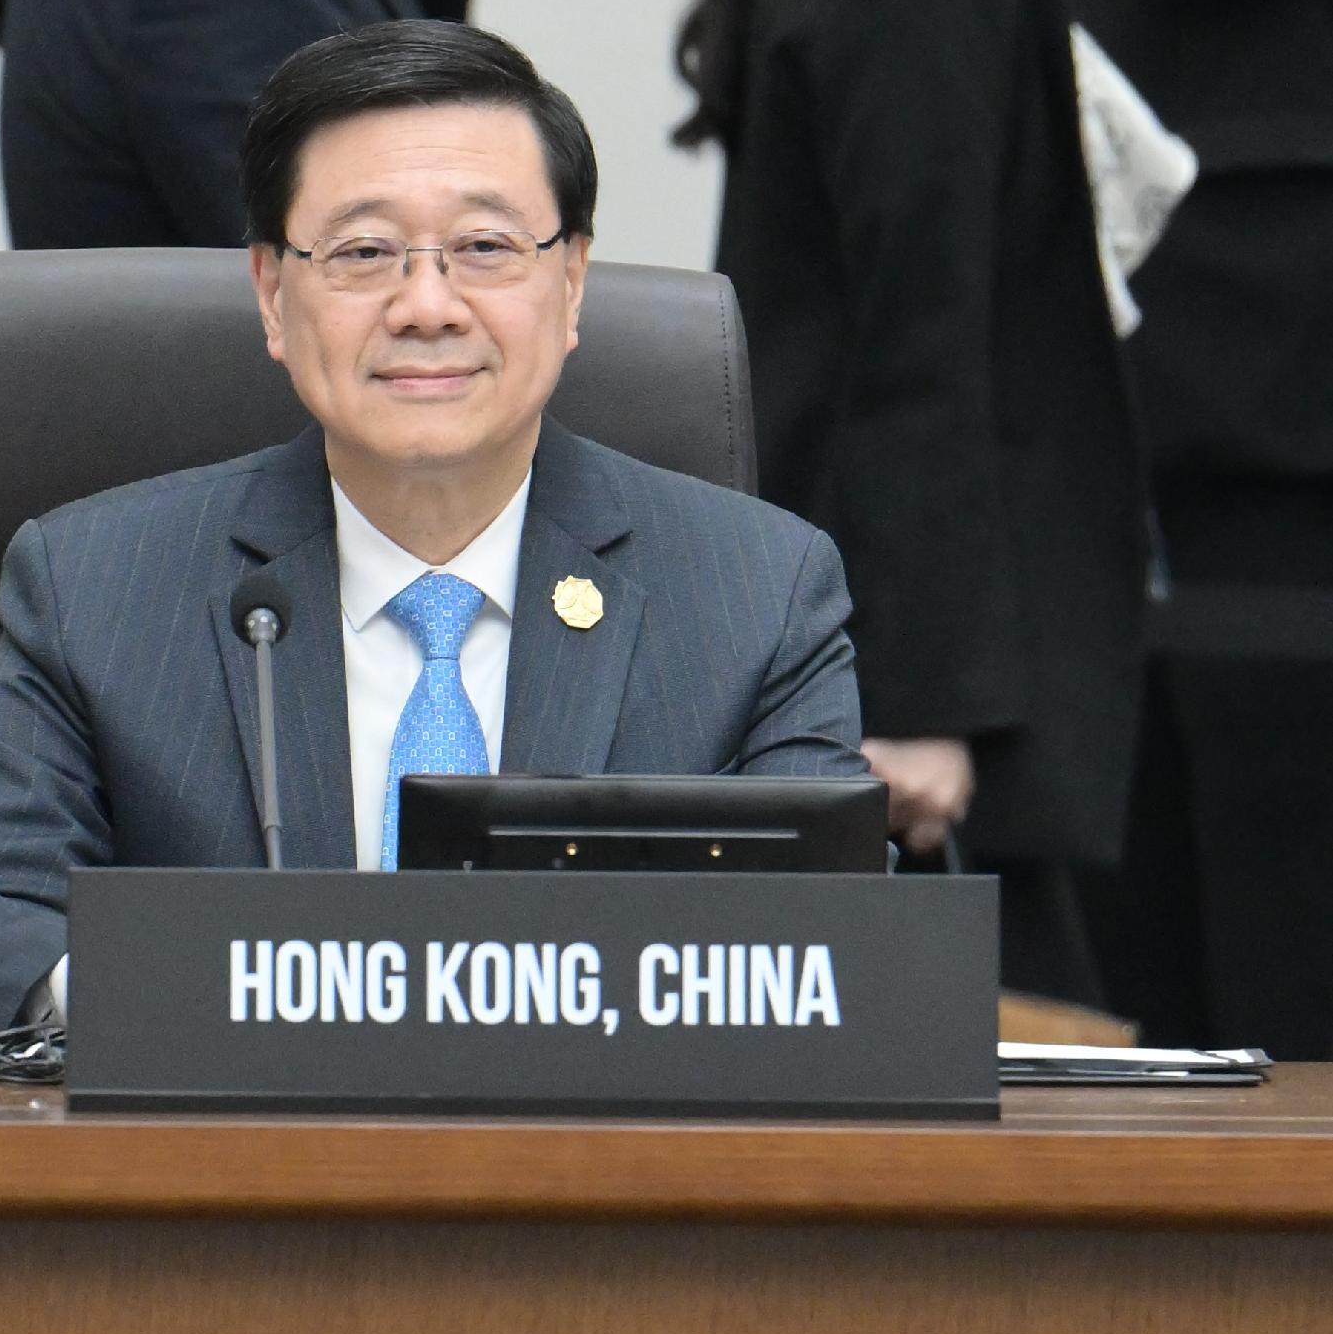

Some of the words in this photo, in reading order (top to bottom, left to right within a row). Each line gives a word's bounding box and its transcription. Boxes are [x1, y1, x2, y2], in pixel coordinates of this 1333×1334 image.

[229, 939, 407, 1024] HONG
[425, 941, 620, 1037] KONG,
[638, 943, 841, 1027] CHINA
